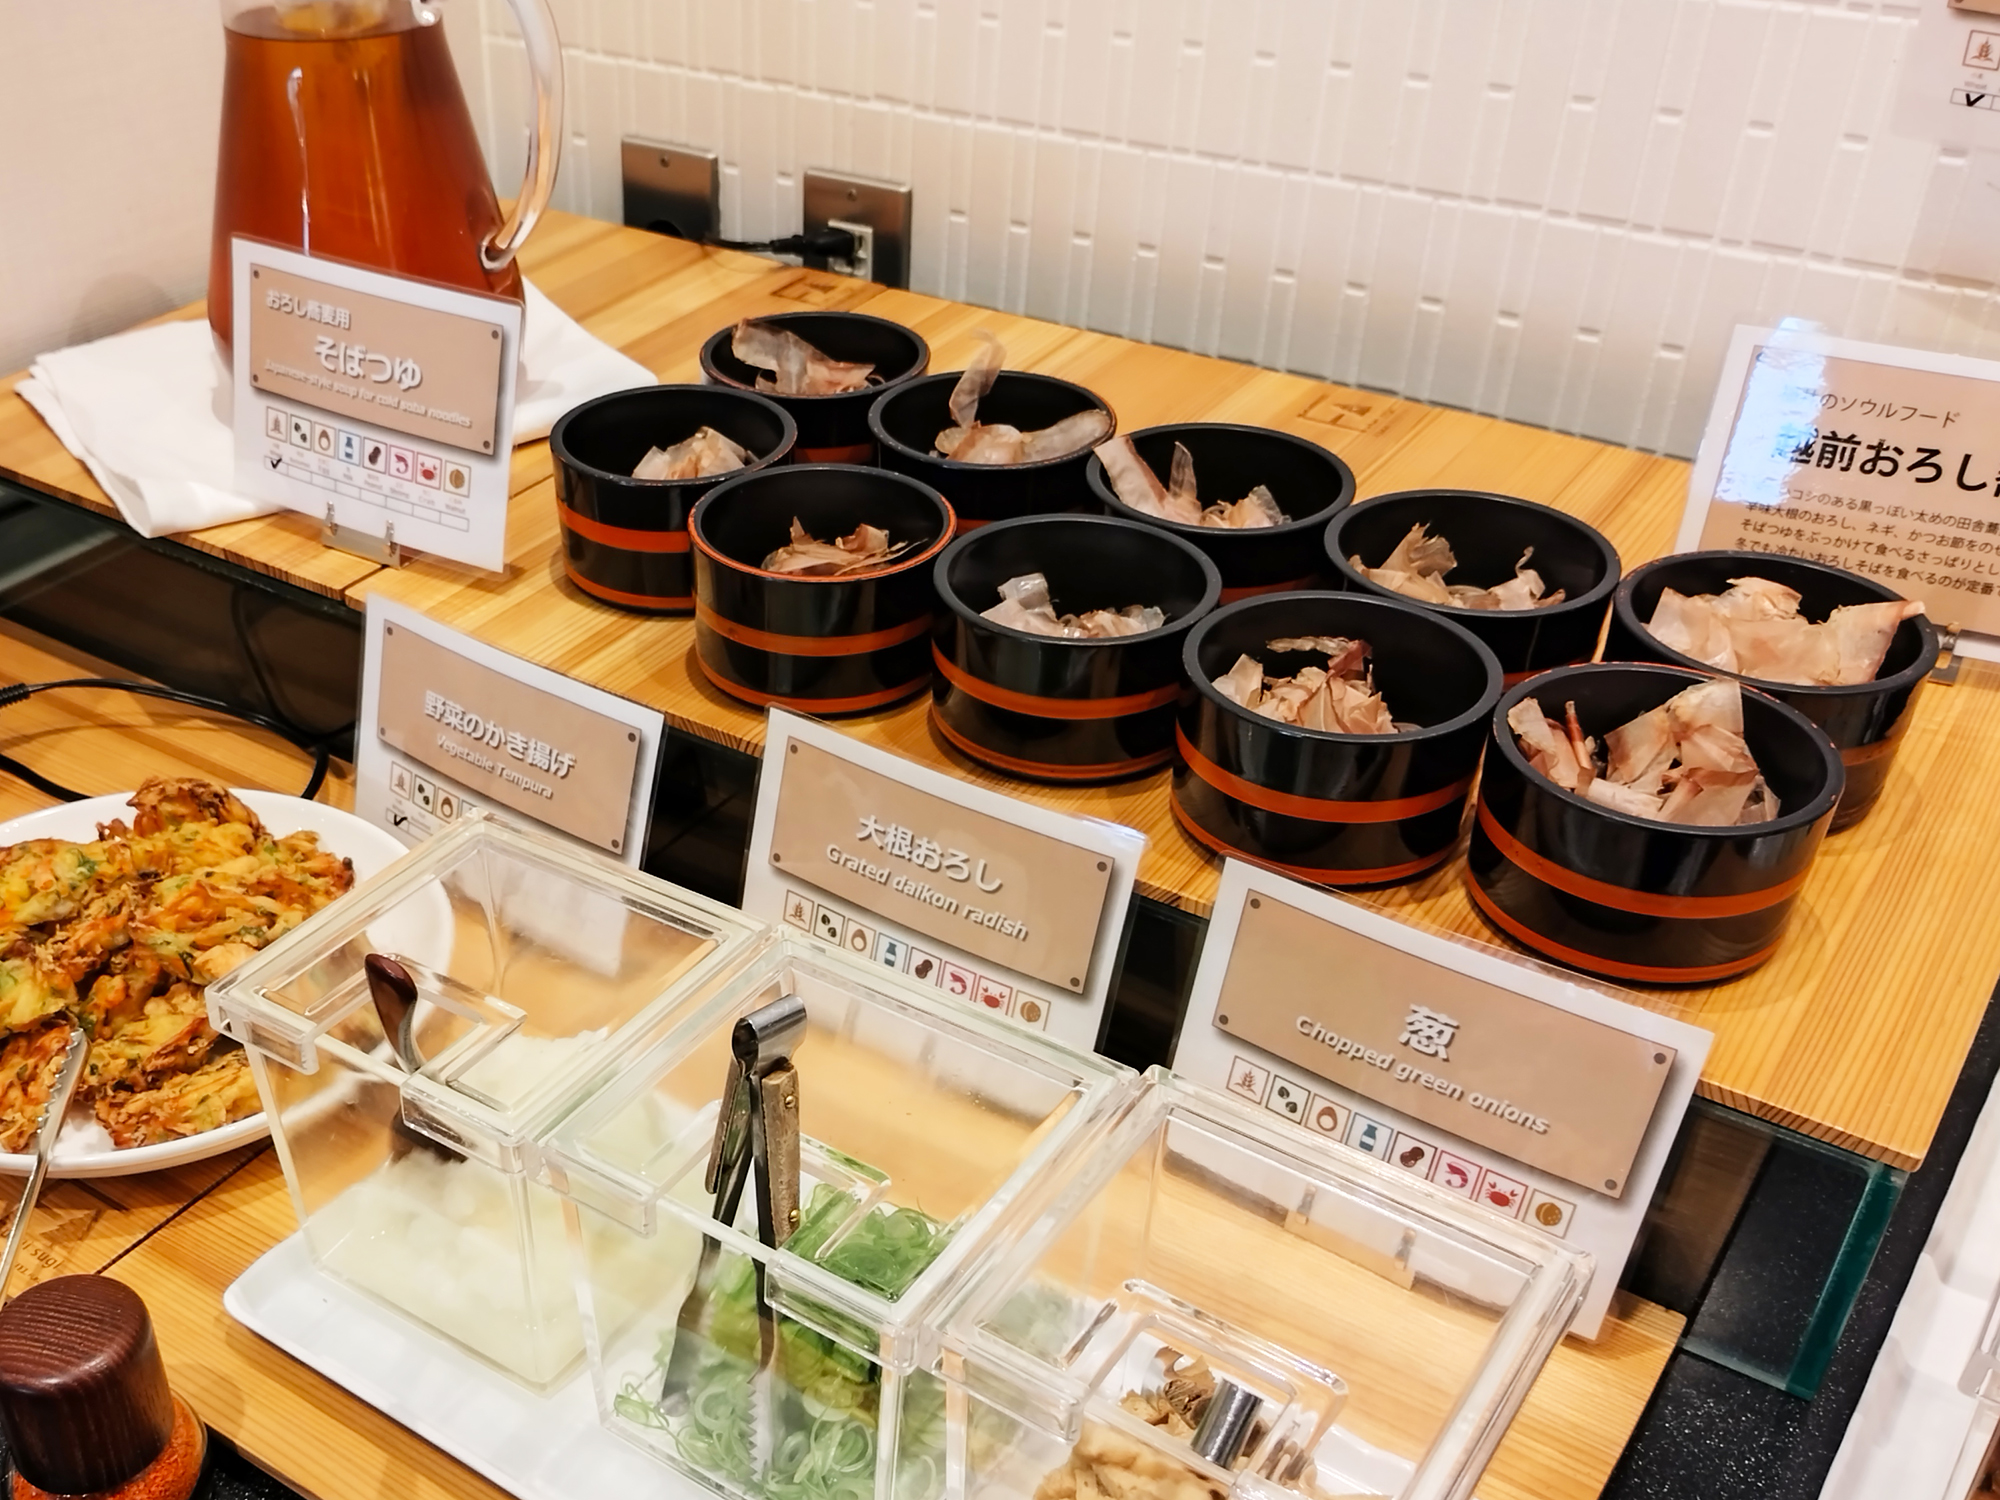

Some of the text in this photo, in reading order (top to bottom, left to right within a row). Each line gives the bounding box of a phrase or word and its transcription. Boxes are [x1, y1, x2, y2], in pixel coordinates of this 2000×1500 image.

[266, 289, 351, 330] おろし蕎麦用
[313, 335, 422, 391] そばつゆ
[334, 382, 358, 398] soup
[360, 388, 375, 403] for
[377, 392, 399, 409] cold
[401, 400, 427, 416] soba
[427, 408, 472, 428] noodles
[1773, 426, 2000, 498] 前おろし
[424, 689, 577, 779] 野菜のかき揚げ
[436, 733, 554, 800] Vegetable Tempura
[857, 813, 1003, 894] 大根おろし
[826, 843, 1029, 943] Grated daikon radish
[1398, 1003, 1460, 1062] 葱
[1296, 1015, 1552, 1136] Chopped green onions
